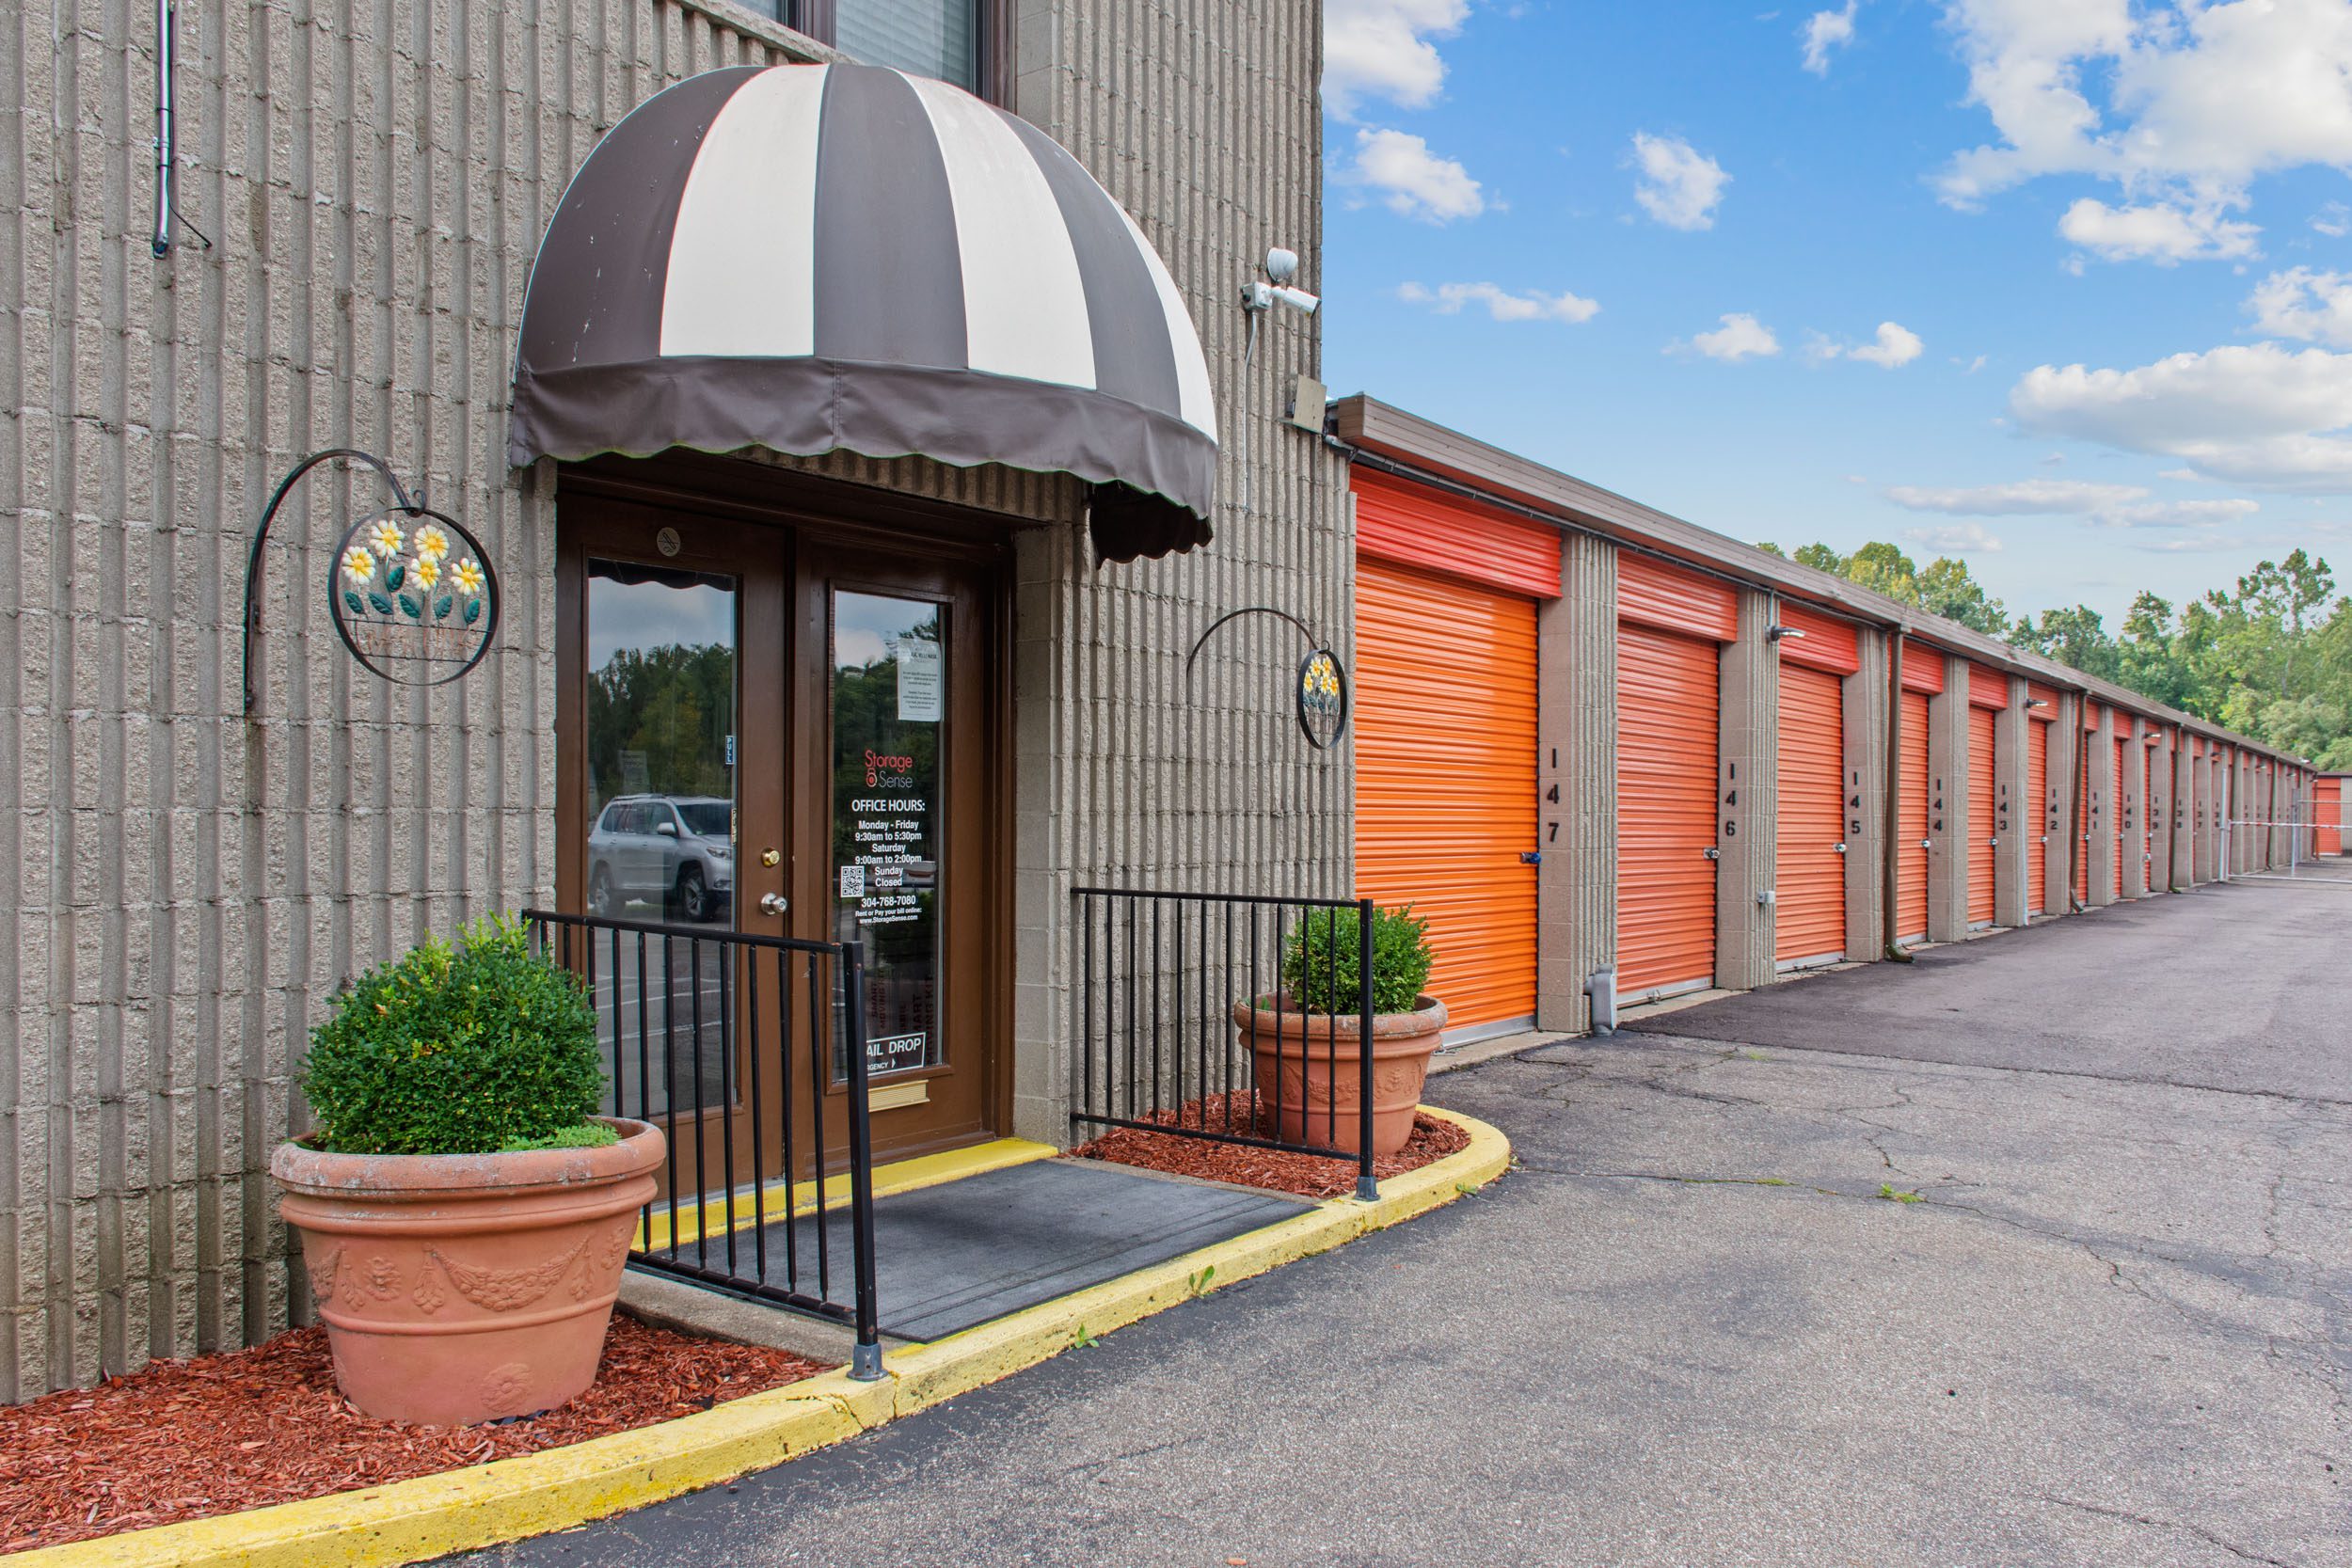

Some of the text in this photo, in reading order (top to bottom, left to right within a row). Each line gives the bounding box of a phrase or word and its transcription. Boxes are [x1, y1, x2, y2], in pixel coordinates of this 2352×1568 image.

[866, 749, 913, 773] Storage
[879, 770, 913, 788] Sense
[1547, 748, 1560, 843] 147
[1725, 763, 1737, 836] 146
[1850, 771, 1861, 834] 145
[851, 799, 926, 812] OFFICE HOURS:
[1933, 779, 1943, 832] 144
[1999, 784, 2008, 831] 143
[2049, 788, 2058, 830] 142
[858, 820, 889, 831] Monday
[896, 819, 919, 831] Friday
[855, 832, 922, 842] 9:30am to 5:30pm
[872, 843, 906, 853] Saturday
[855, 854, 922, 864] 9:00am to 2:00pm
[875, 866, 904, 877] Sunday
[875, 877, 903, 887] Closed
[861, 895, 916, 908] 304-768-7080
[859, 914, 918, 924] www.StorageSense.com
[866, 1037, 922, 1057] AIL DROP
